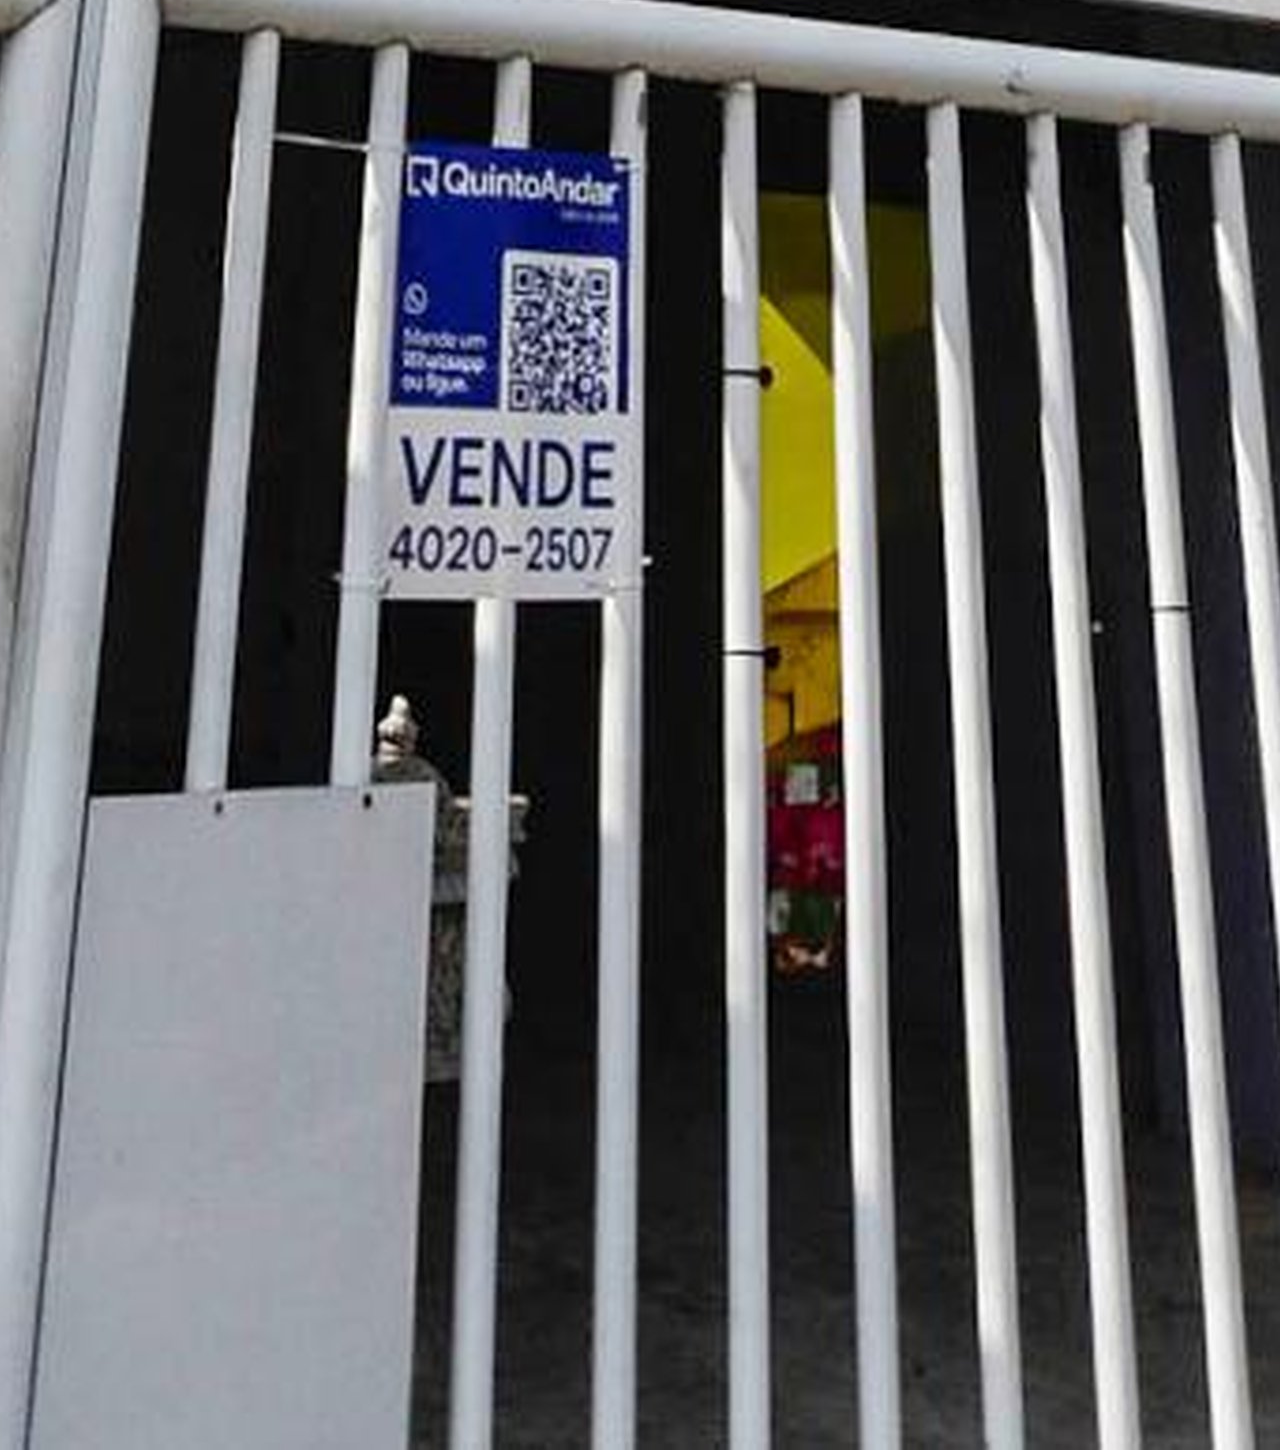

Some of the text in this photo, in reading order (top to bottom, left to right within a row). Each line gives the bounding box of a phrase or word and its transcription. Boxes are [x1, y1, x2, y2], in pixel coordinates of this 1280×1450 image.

[443, 161, 619, 206] QuintoAndar
[401, 436, 615, 508] VENDE
[389, 525, 613, 572] 4020-2507
